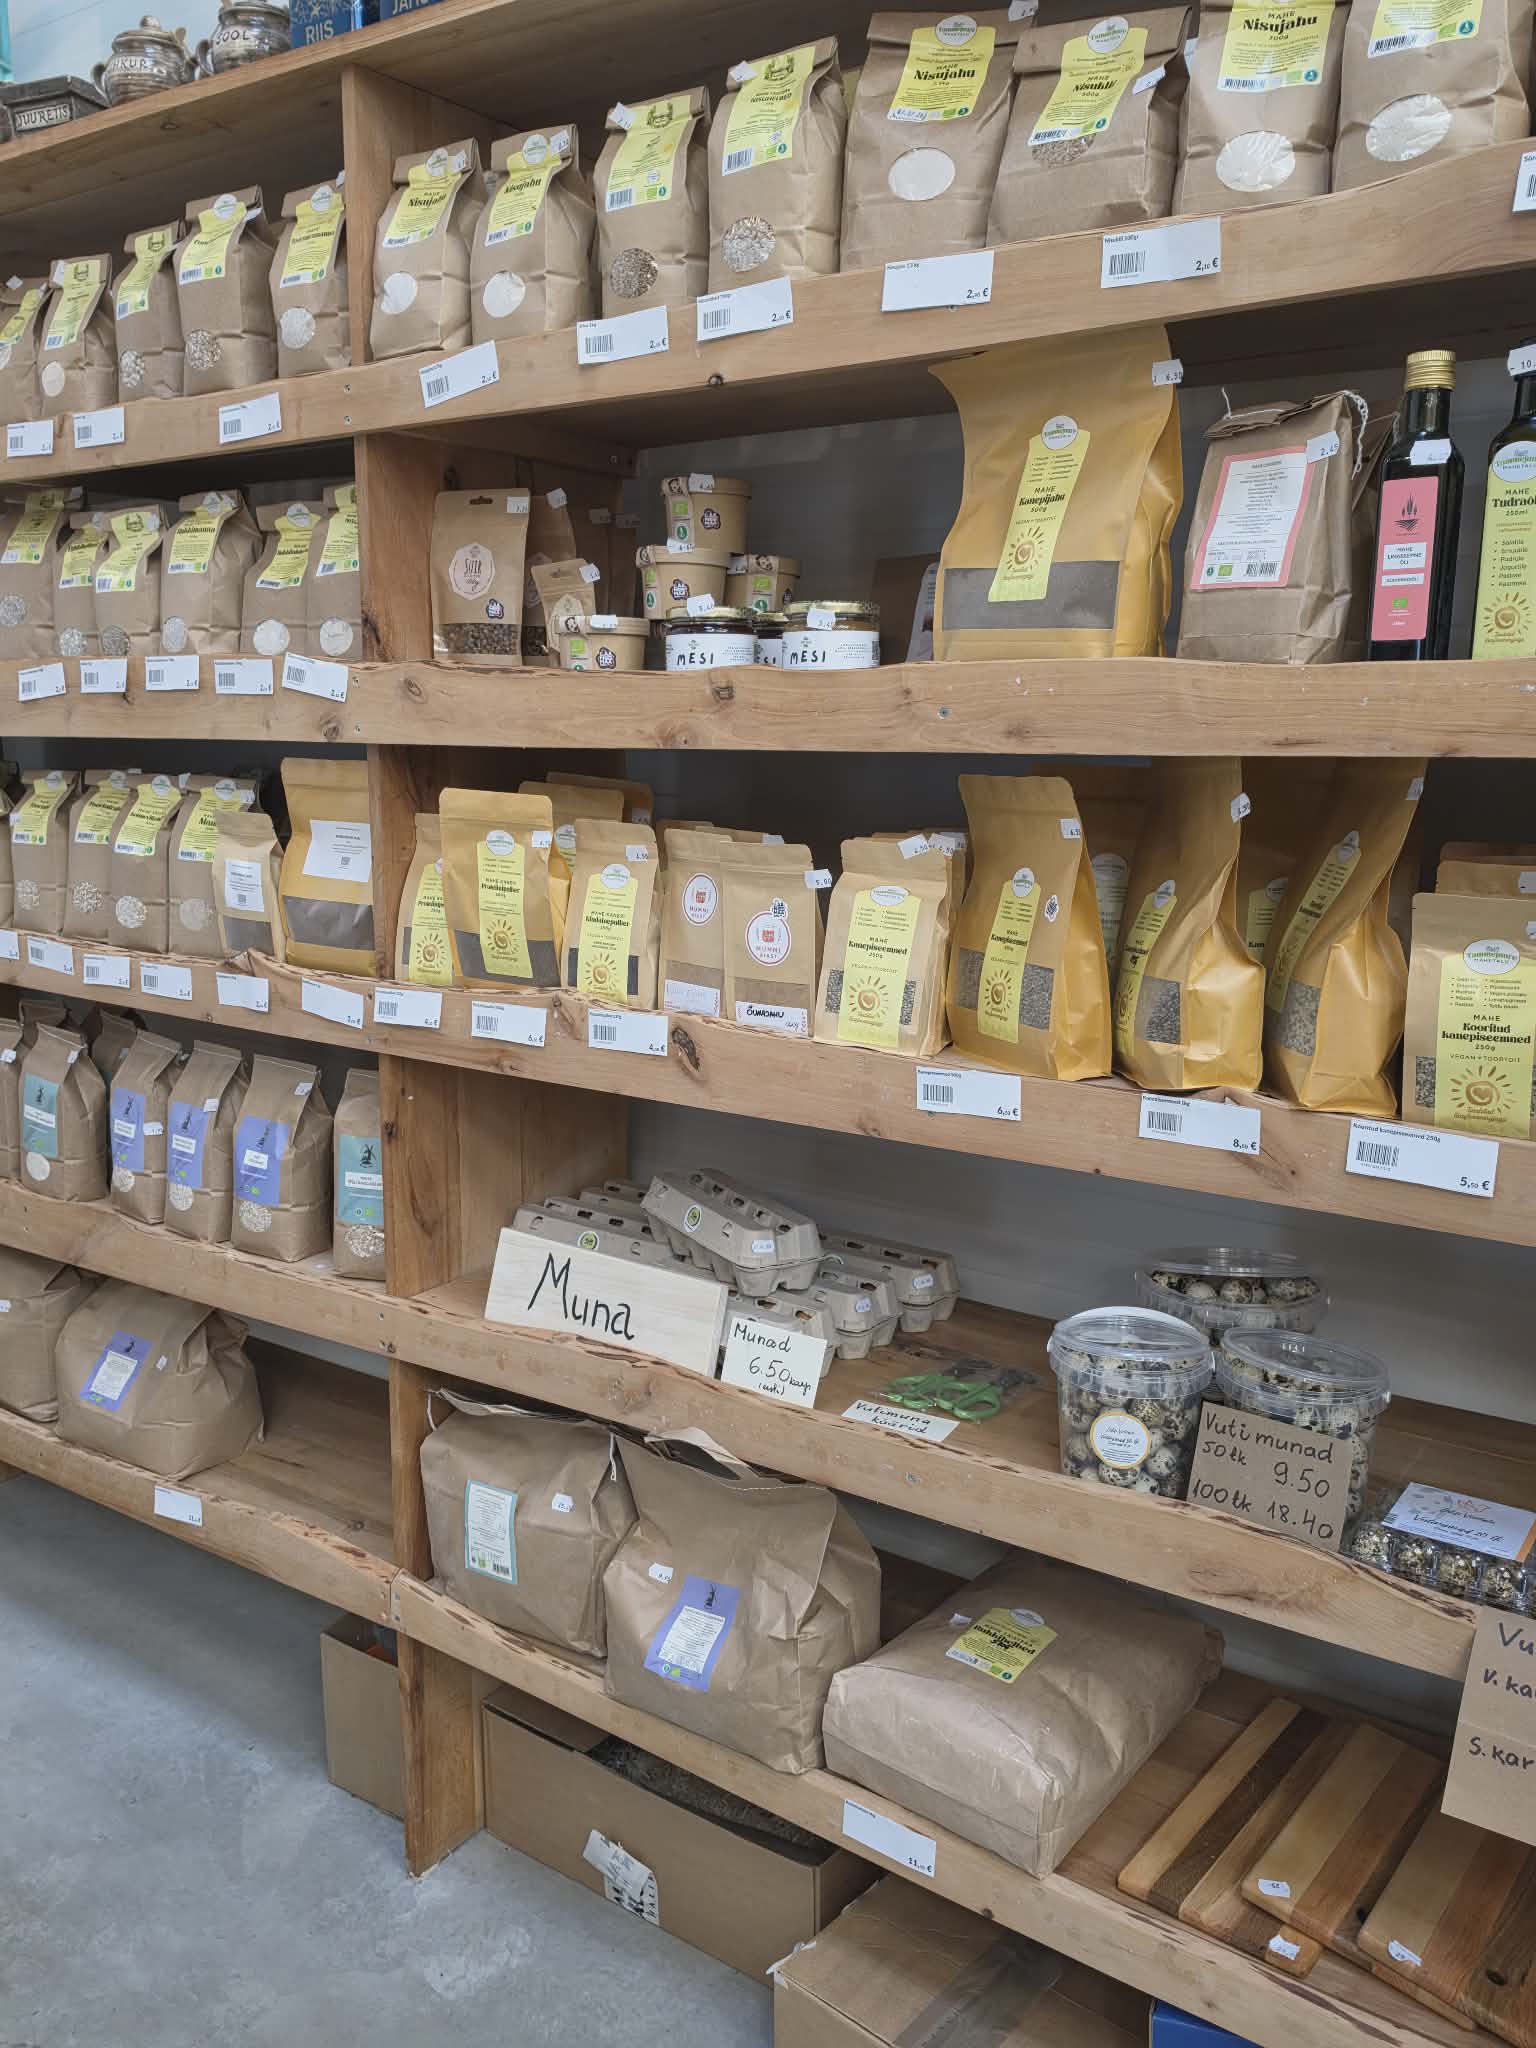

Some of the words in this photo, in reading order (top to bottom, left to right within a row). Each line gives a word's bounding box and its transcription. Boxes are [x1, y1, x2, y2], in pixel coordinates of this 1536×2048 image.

[1242, 14, 1318, 35] Nisujahu
[305, 20, 335, 45] RIIS
[913, 68, 976, 82] Nisujahu
[1034, 485, 1056, 494] MAHE
[1504, 488, 1530, 496] MAHE
[677, 652, 715, 667] MESI
[790, 649, 827, 664] MESI
[1473, 1014, 1501, 1022] MAHE
[1462, 1022, 1511, 1034] Kooritud
[1441, 1030, 1531, 1045] kanepiseemned
[1012, 1107, 1019, 1116] €
[1250, 1141, 1257, 1151] €
[1459, 1176, 1479, 1189] 5,50
[1482, 1180, 1490, 1191] €
[527, 1252, 635, 1341] Muna
[733, 1322, 792, 1353] Munad
[1274, 1461, 1330, 1498] 9.50
[1267, 1499, 1334, 1539] 18.40
